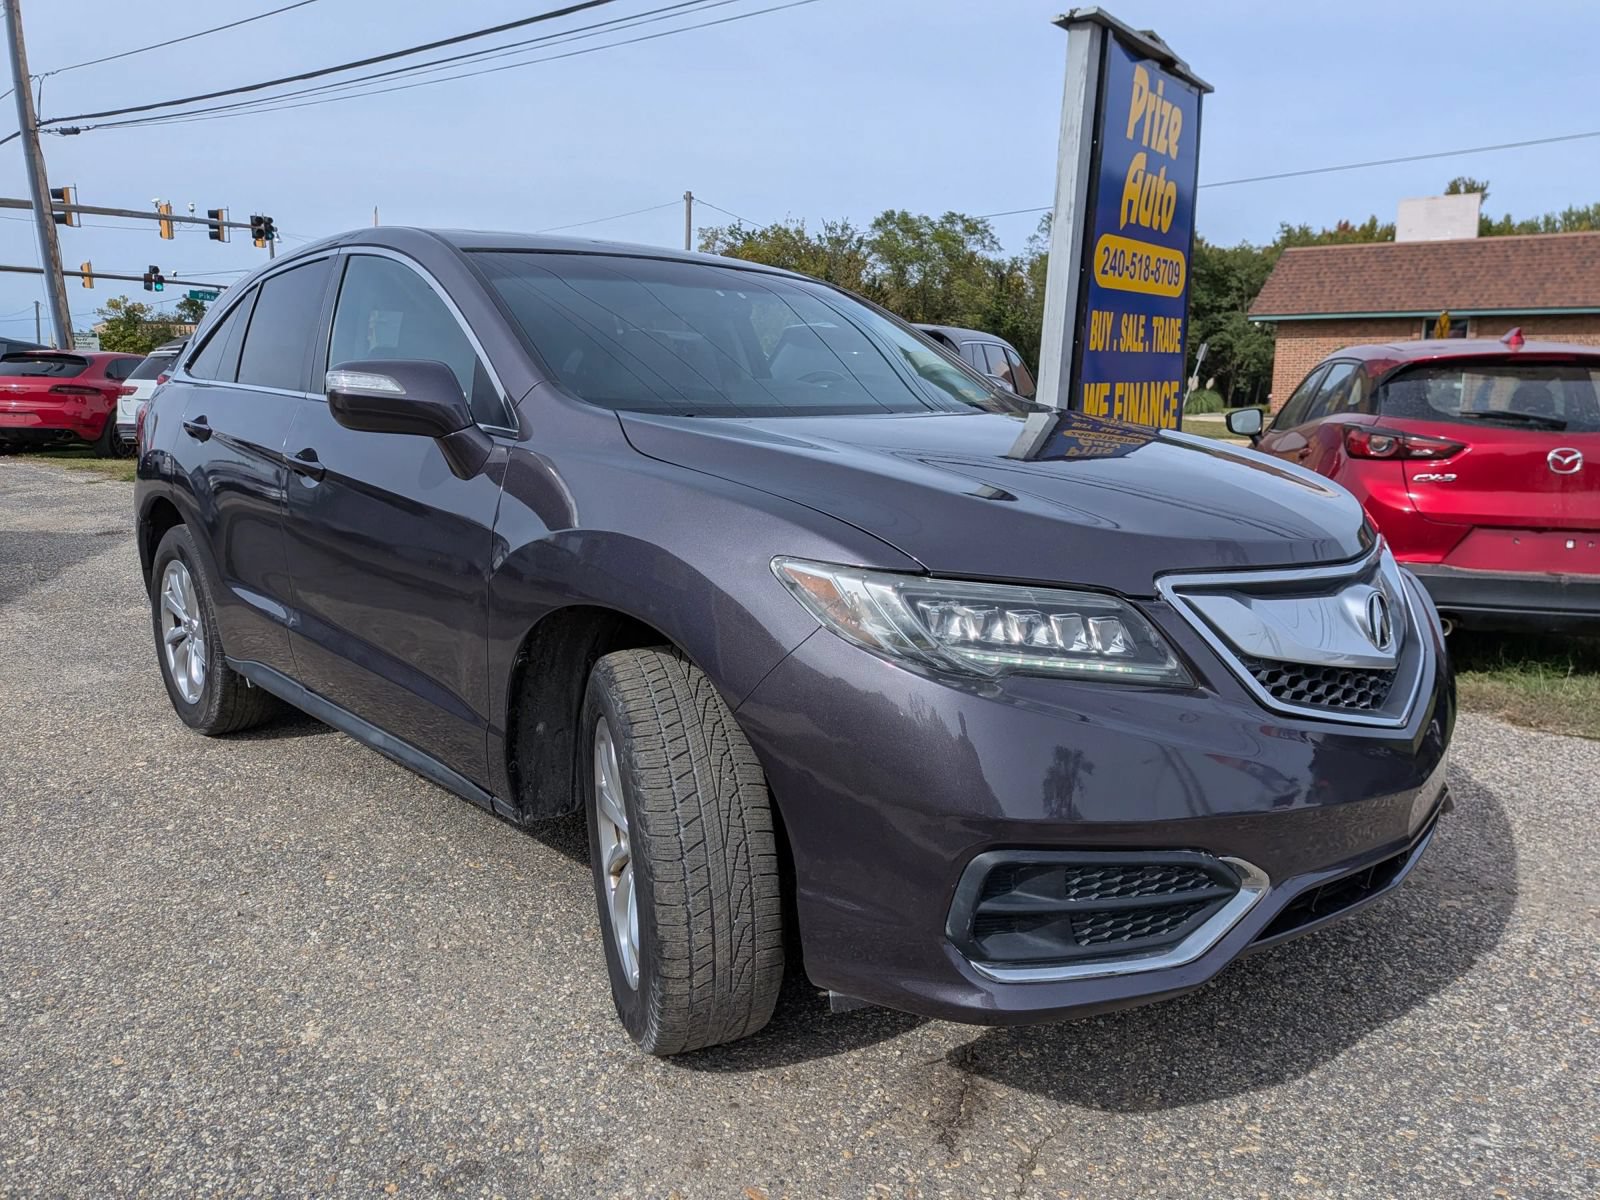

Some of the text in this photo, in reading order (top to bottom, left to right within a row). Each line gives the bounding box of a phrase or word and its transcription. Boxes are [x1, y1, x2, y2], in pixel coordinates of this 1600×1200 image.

[1126, 64, 1183, 160] Prize
[1119, 152, 1177, 234] Auto
[1101, 246, 1181, 287] 240-518-8709
[1089, 310, 1114, 351] BUY
[1120, 313, 1146, 353] SALE
[1152, 316, 1182, 353] TRADE
[1114, 381, 1180, 429] FINANCE
